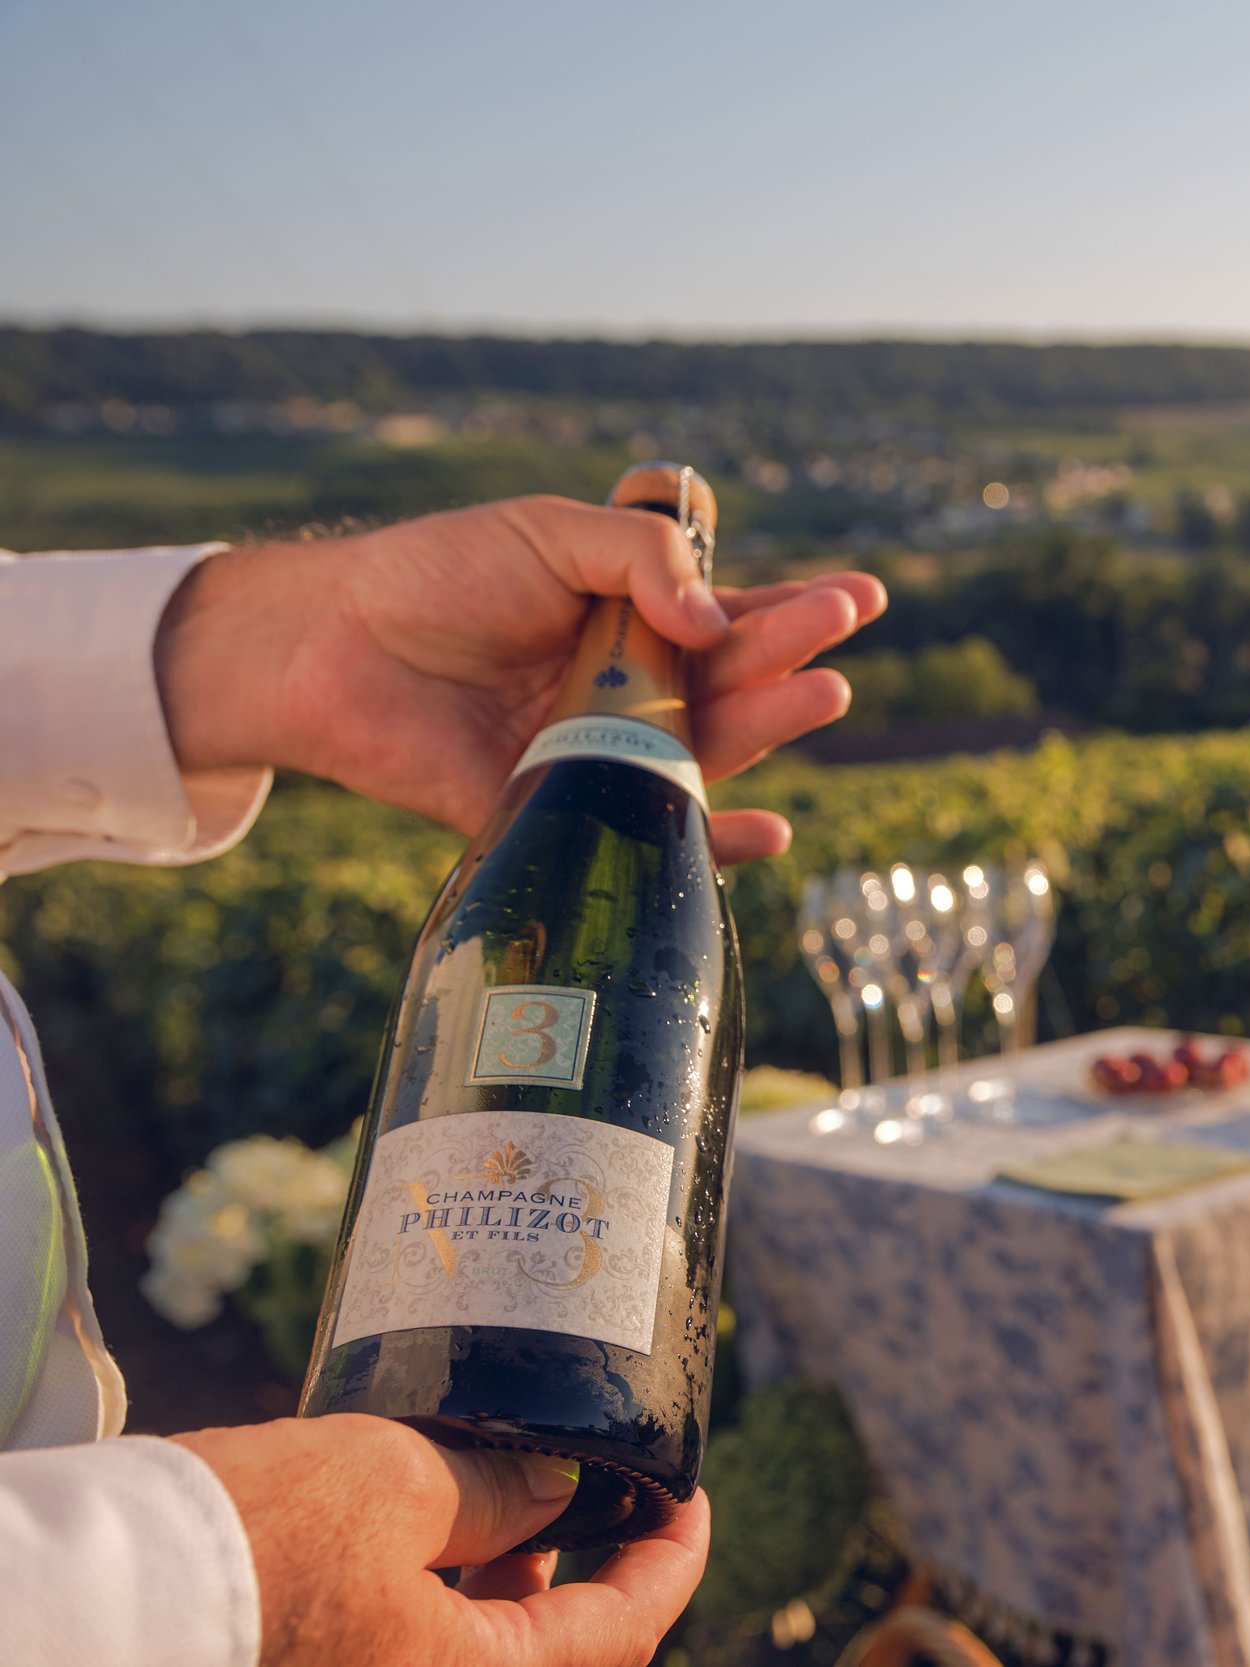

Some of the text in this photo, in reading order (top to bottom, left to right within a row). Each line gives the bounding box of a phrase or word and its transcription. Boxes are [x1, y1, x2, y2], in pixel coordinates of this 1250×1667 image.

[499, 1000, 559, 1069] 3
[426, 1190, 582, 1209] CHAMPAGNE
[396, 1205, 610, 1240] PHILIZOT
[451, 1230, 540, 1242] ET FILS
[472, 1265, 510, 1276] BRUT
